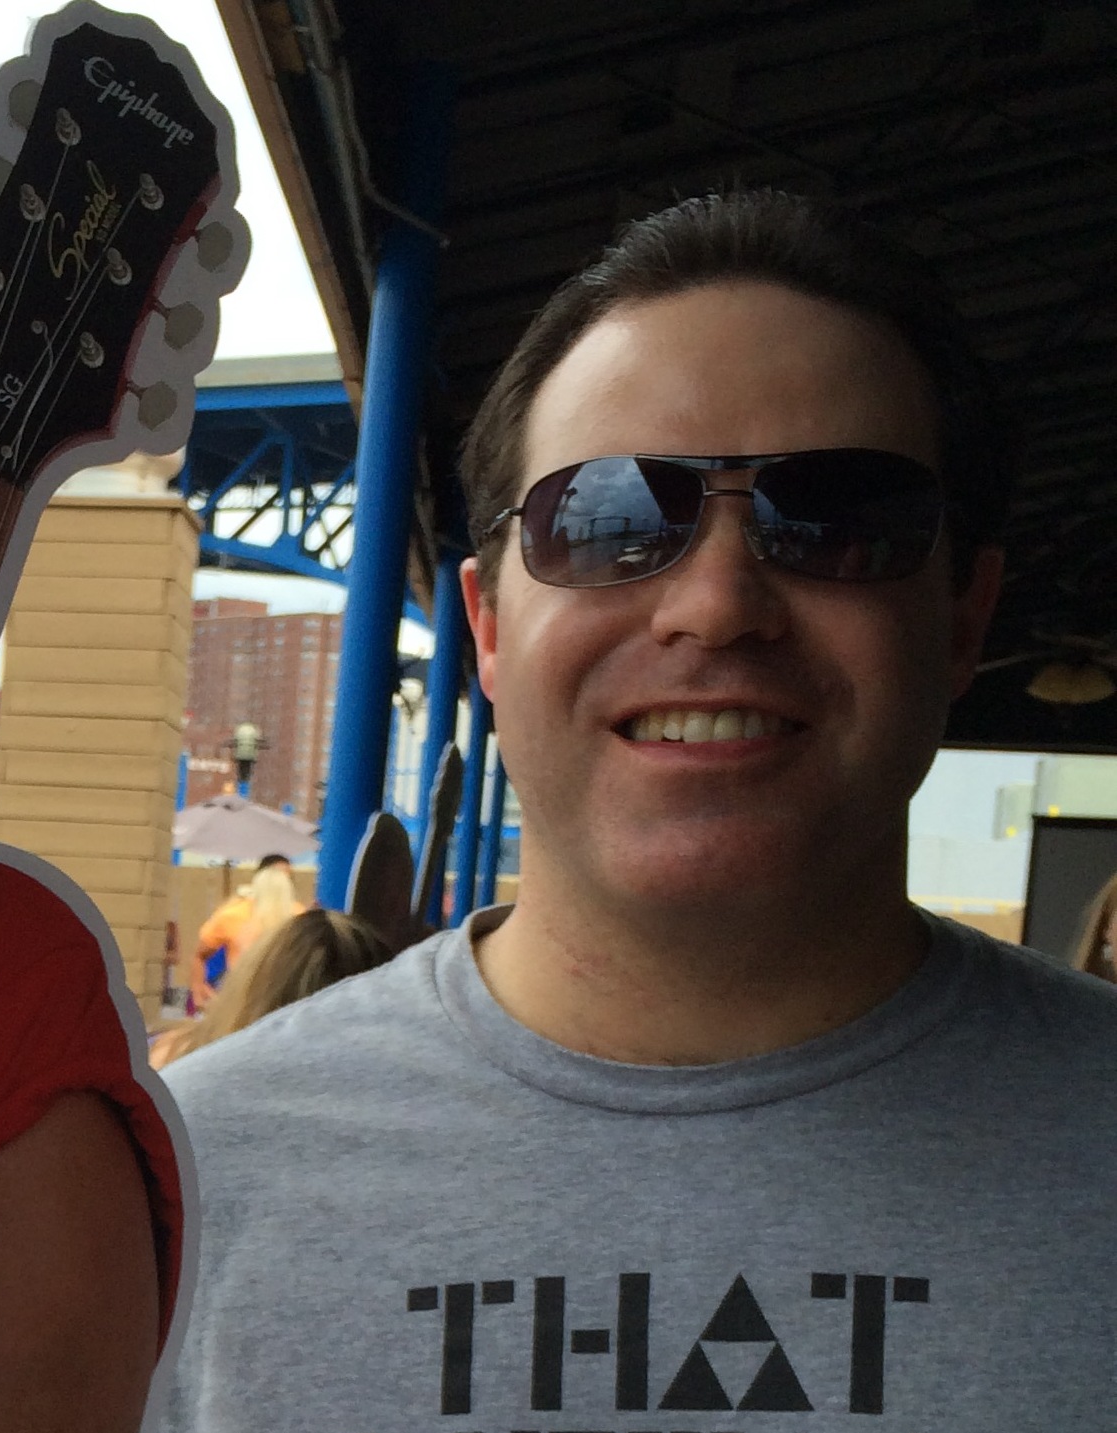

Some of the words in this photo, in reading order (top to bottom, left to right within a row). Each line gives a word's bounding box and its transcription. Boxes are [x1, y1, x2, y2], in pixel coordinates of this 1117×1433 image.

[82, 56, 194, 148] Epiphone
[48, 160, 116, 301] Special
[407, 1272, 929, 1415] THAT
